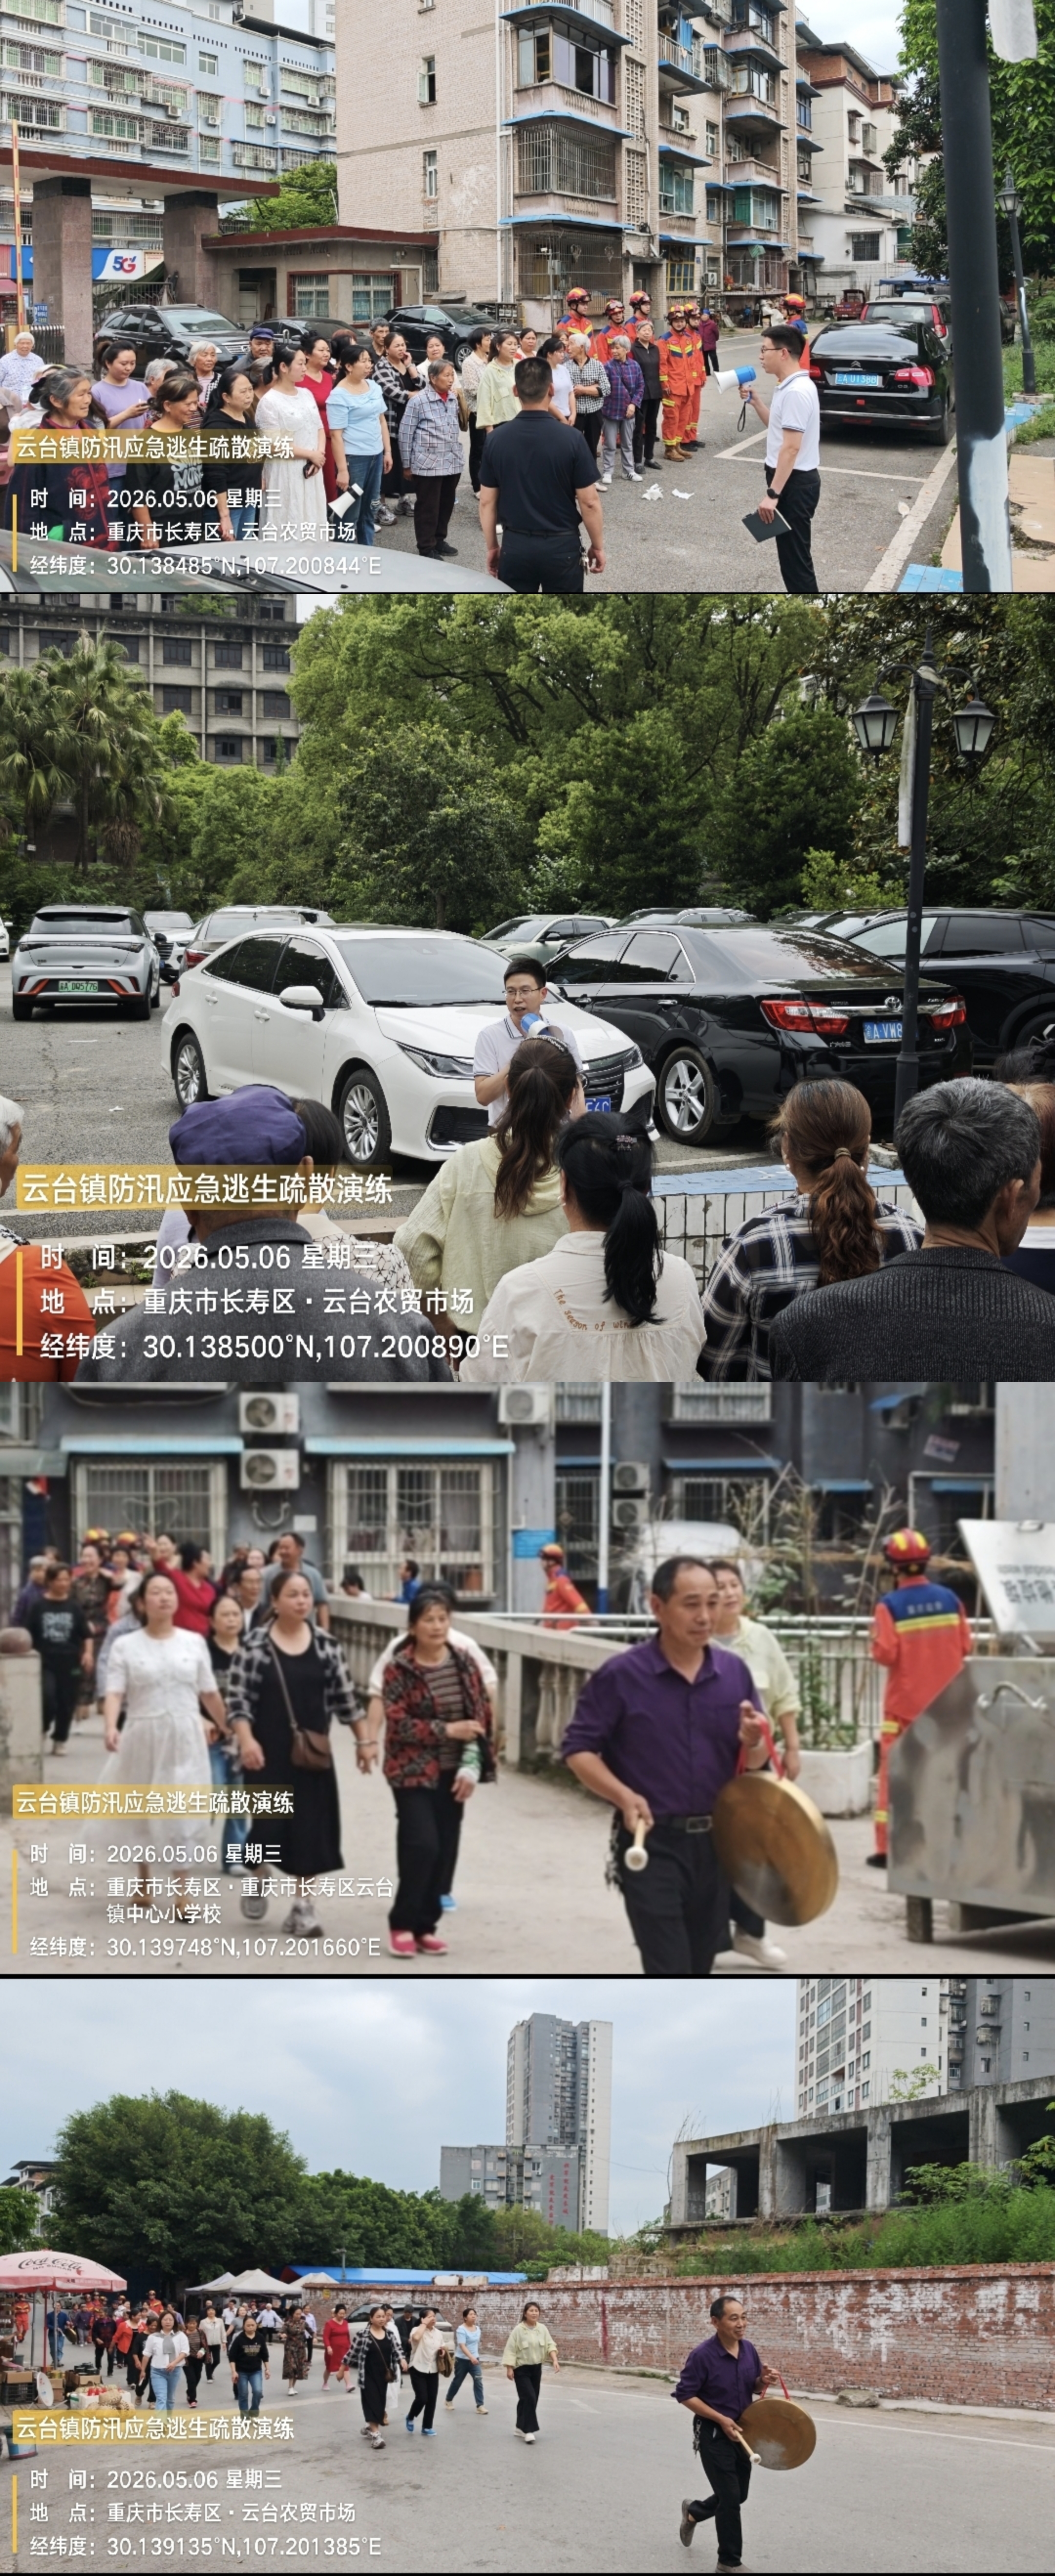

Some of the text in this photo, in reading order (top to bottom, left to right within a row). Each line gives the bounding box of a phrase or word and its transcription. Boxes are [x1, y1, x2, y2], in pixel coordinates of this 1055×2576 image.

[112, 256, 136, 273] 5G
[594, 1321, 605, 1331] of
[613, 1320, 633, 1329] win
